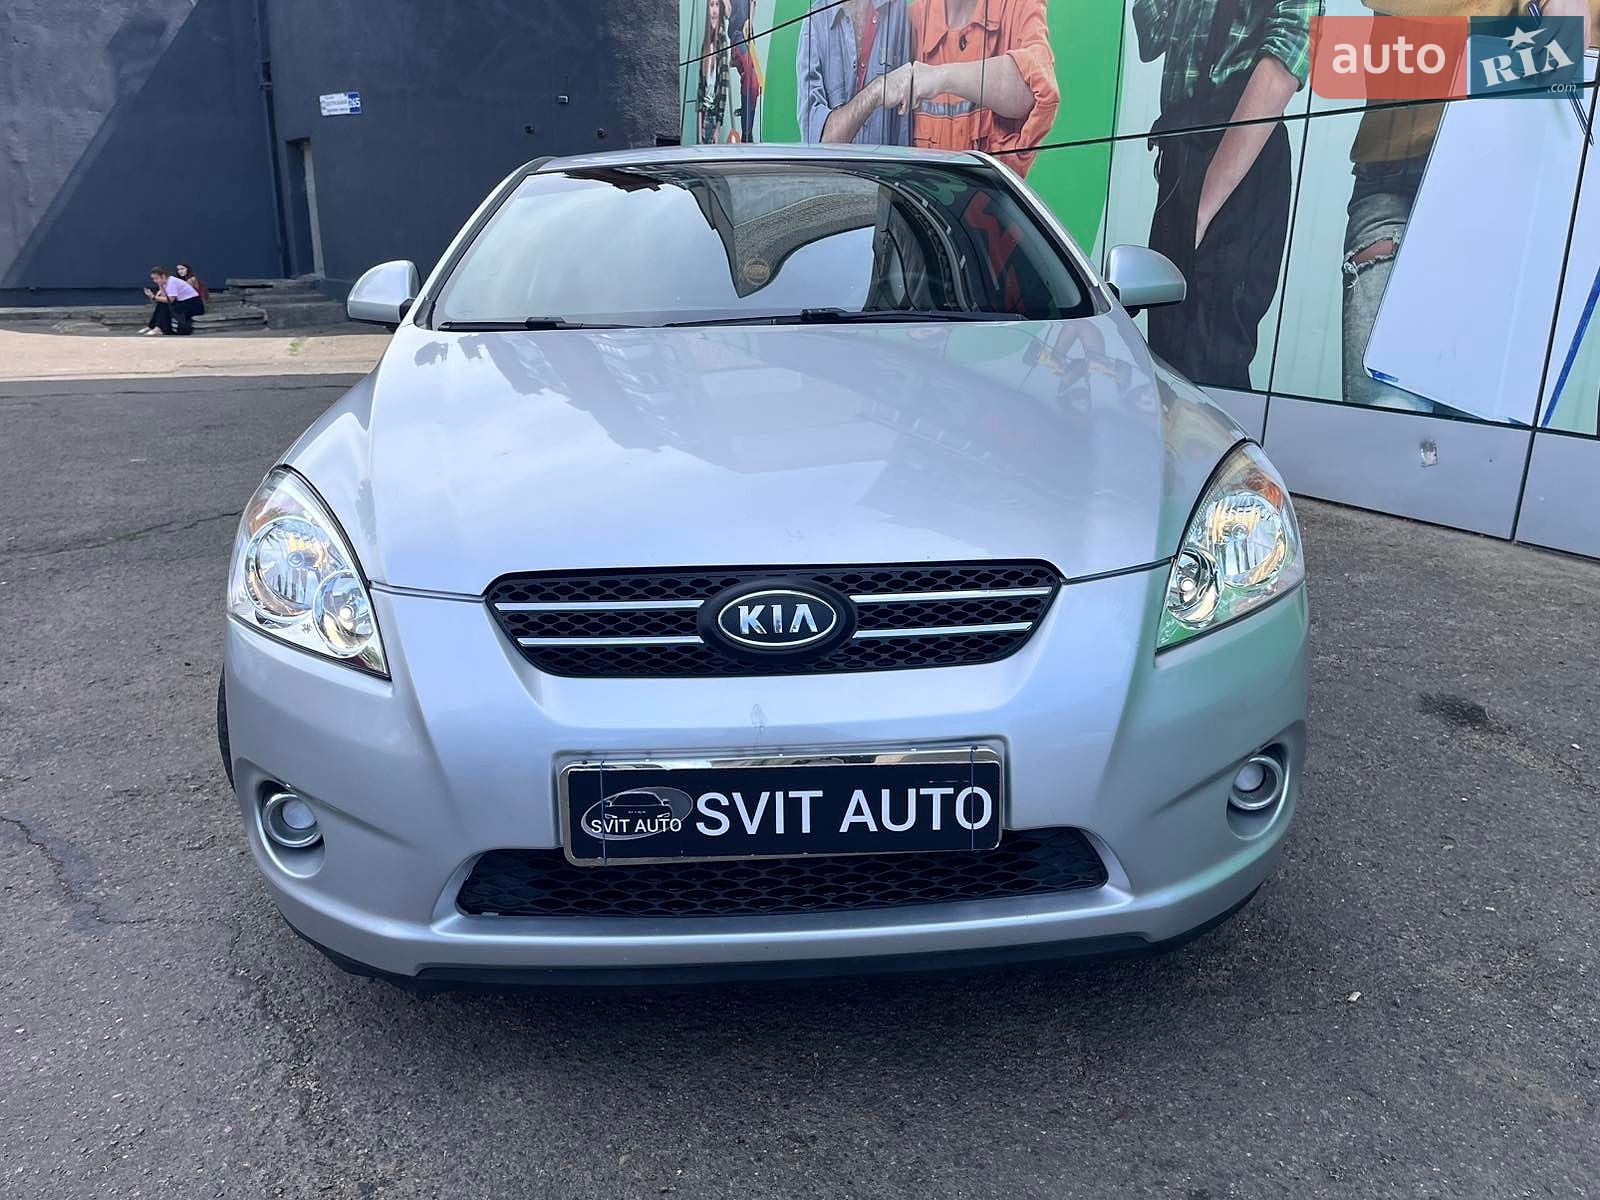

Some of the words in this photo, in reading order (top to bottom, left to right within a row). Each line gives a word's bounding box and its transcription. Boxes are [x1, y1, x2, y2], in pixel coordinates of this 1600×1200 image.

[738, 604, 818, 634] KIA
[591, 819, 630, 833] SVIT
[634, 818, 682, 833] AUTO
[696, 790, 824, 837] SVIT
[839, 786, 993, 834] AUTO
